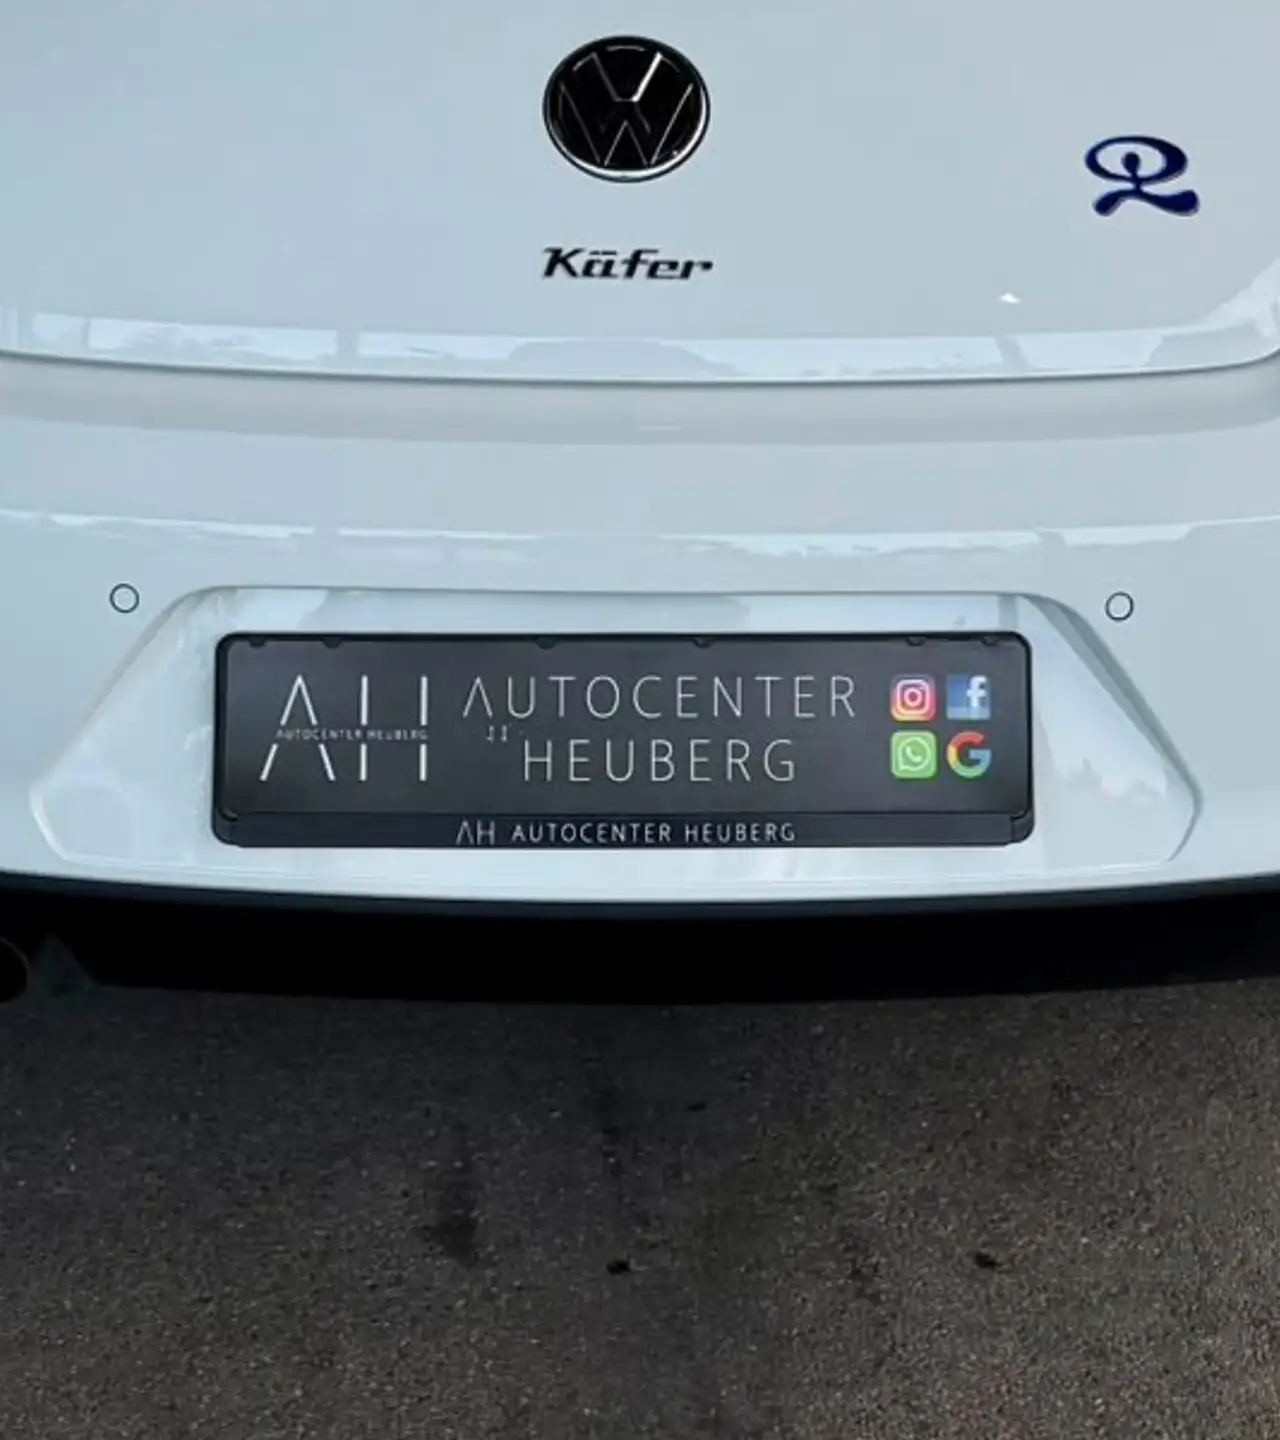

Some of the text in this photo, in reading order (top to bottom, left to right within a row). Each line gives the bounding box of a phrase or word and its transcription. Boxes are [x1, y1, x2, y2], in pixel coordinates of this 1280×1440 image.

[542, 246, 714, 281] Käfer
[463, 675, 857, 719] AUTOCENTER
[260, 674, 429, 782] AH
[524, 738, 796, 782] HEUBERG
[455, 819, 796, 846] AH AUTOCENTER HEUBERG
